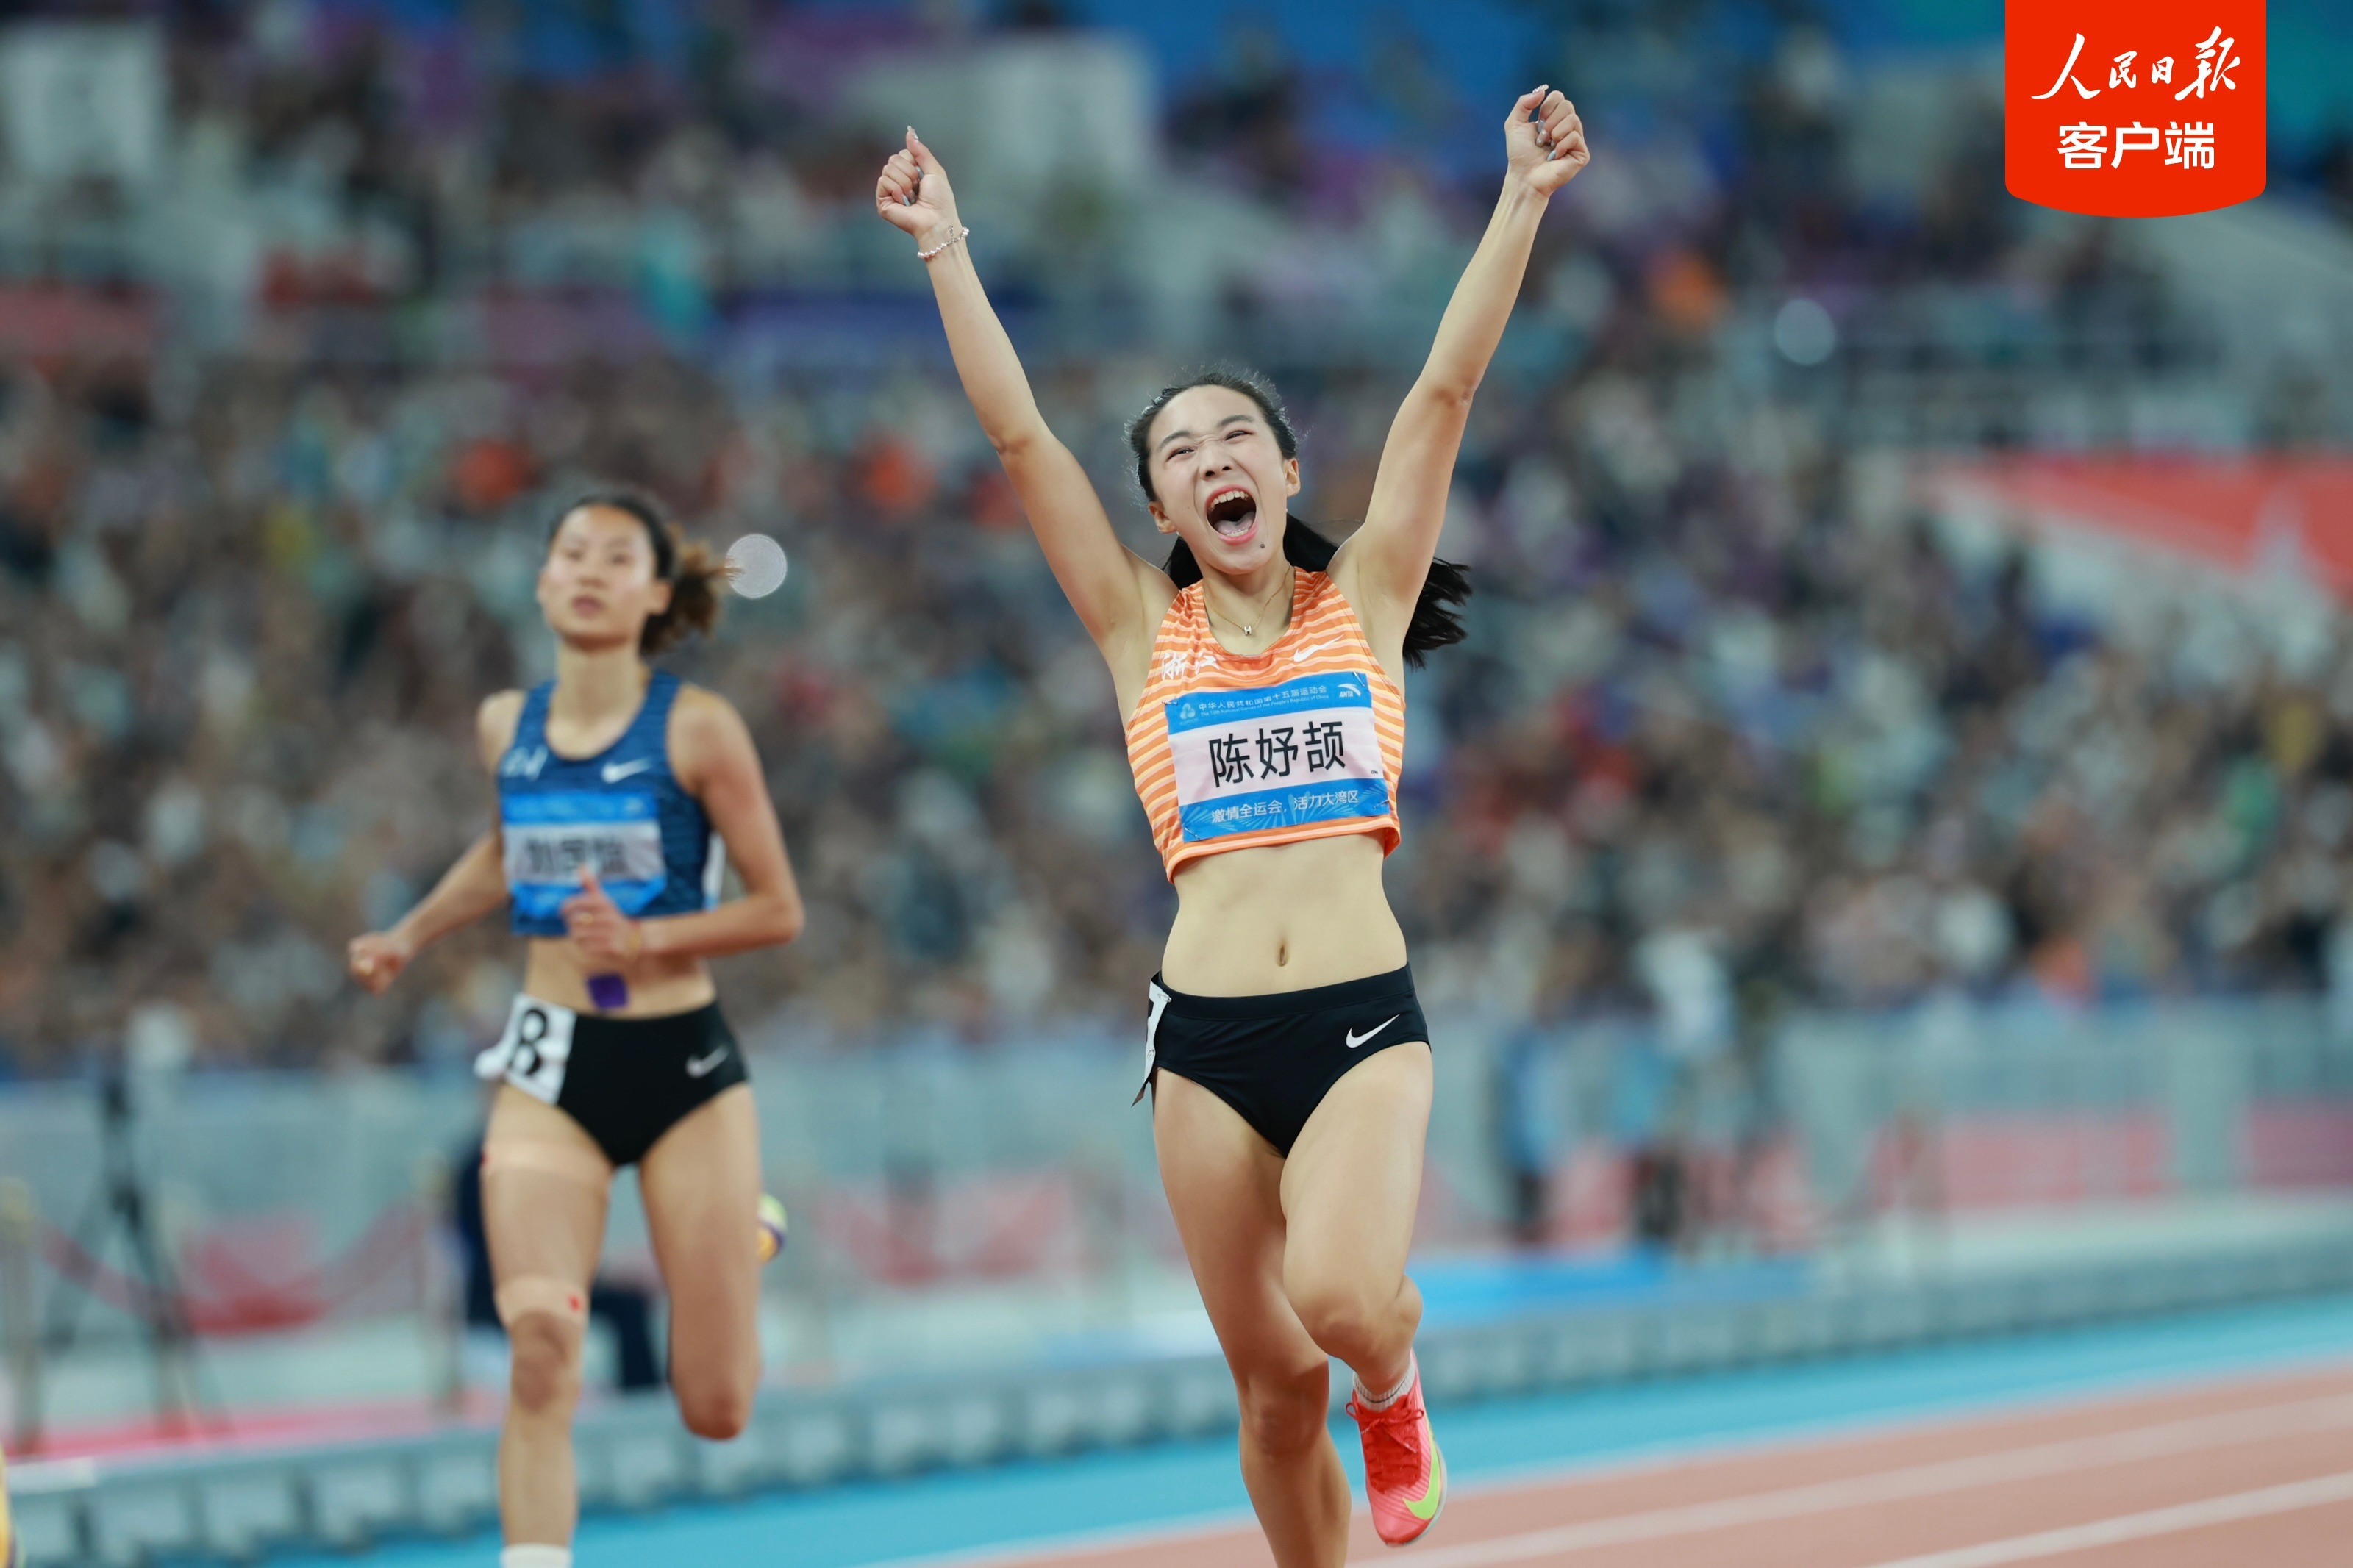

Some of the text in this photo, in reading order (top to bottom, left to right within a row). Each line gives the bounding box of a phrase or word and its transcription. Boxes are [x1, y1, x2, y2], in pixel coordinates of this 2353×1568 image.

[1162, 650, 1221, 680] 浙江
[1199, 685, 1327, 711] 中华人民共和国第十五届运动会
[1339, 690, 1354, 698] ANTA
[1209, 721, 1346, 787] 陈妤颉
[508, 1008, 549, 1077] 8
